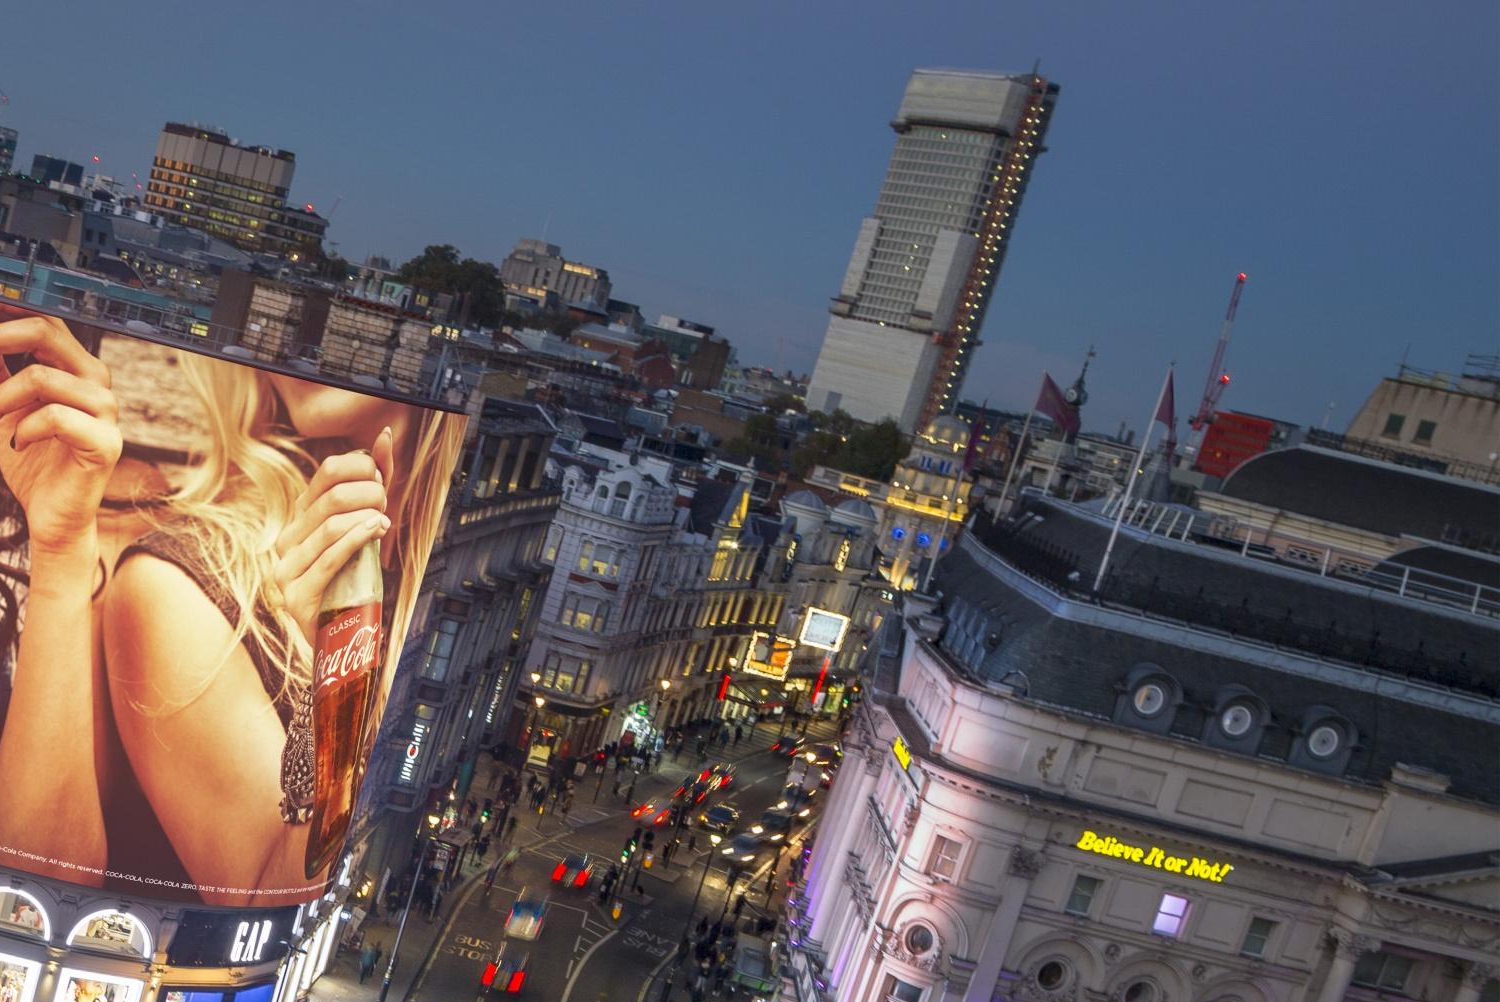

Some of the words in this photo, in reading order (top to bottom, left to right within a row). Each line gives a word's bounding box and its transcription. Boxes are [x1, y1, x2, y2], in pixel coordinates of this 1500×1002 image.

[328, 614, 361, 636] CLASSIC
[313, 622, 379, 690] Coca-Cola
[1076, 830, 1144, 862] Believe
[1143, 847, 1165, 868] It
[1164, 856, 1188, 873] or
[1185, 857, 1231, 882] Not!
[48, 858, 58, 866] All
[58, 859, 76, 870] rights
[145, 877, 180, 888] COCA-COLA
[226, 887, 247, 895] FEELING
[230, 919, 273, 962] GAP
[454, 934, 492, 950] BUS
